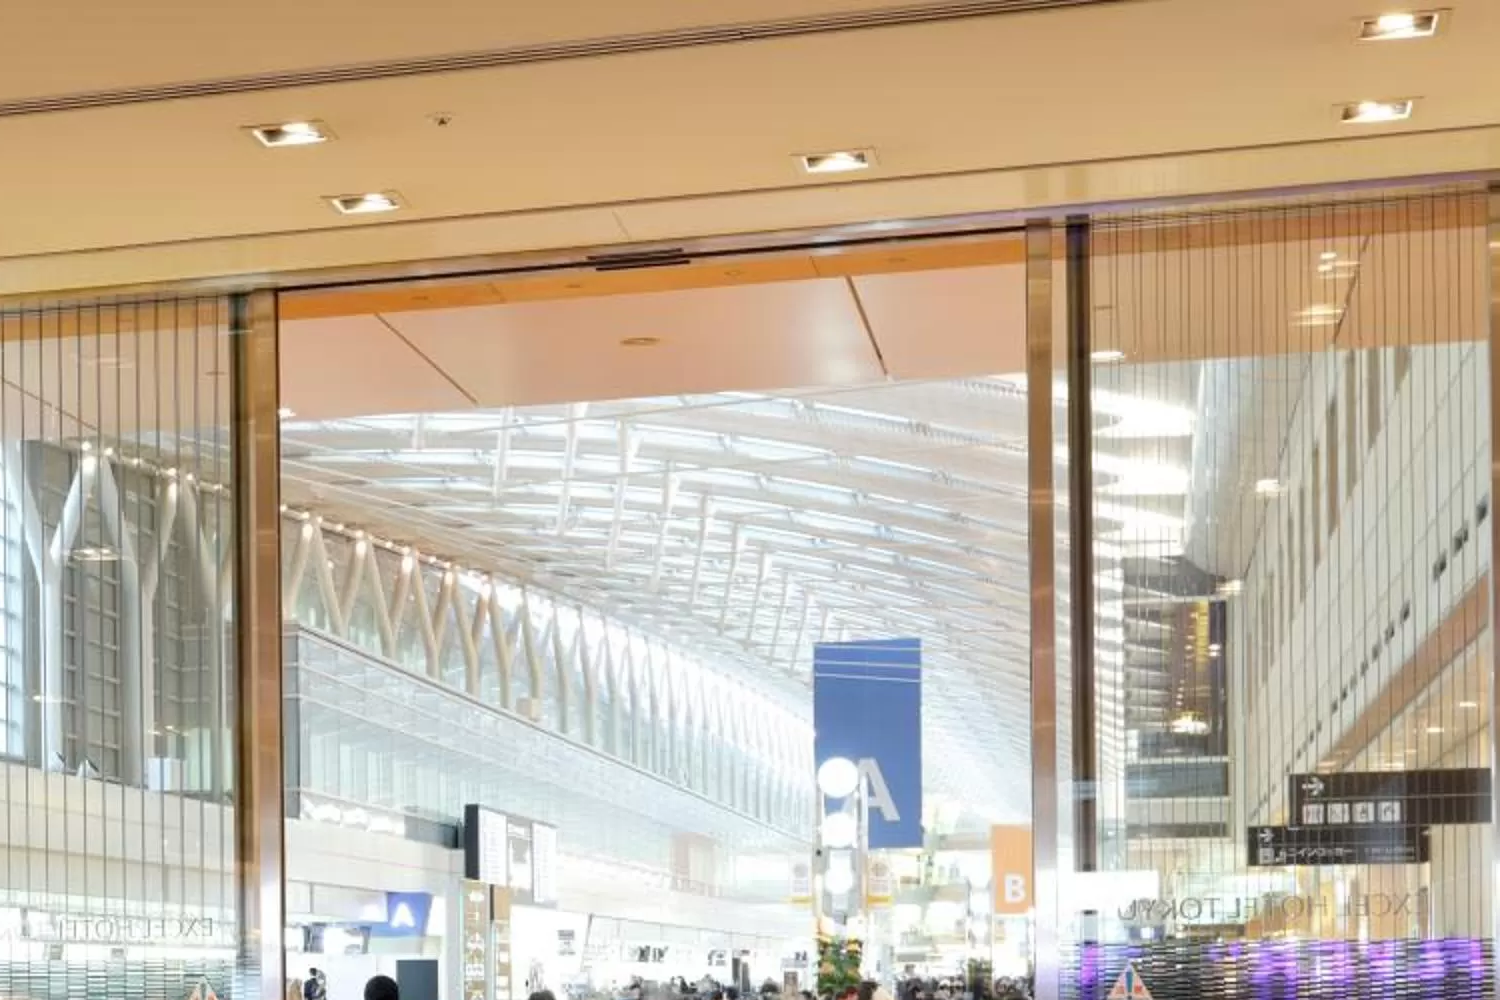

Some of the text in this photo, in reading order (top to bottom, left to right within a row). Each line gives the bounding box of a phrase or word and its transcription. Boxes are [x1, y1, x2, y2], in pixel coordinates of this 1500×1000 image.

[840, 757, 900, 822] A
[1005, 874, 1026, 903] B
[391, 903, 415, 927] A
